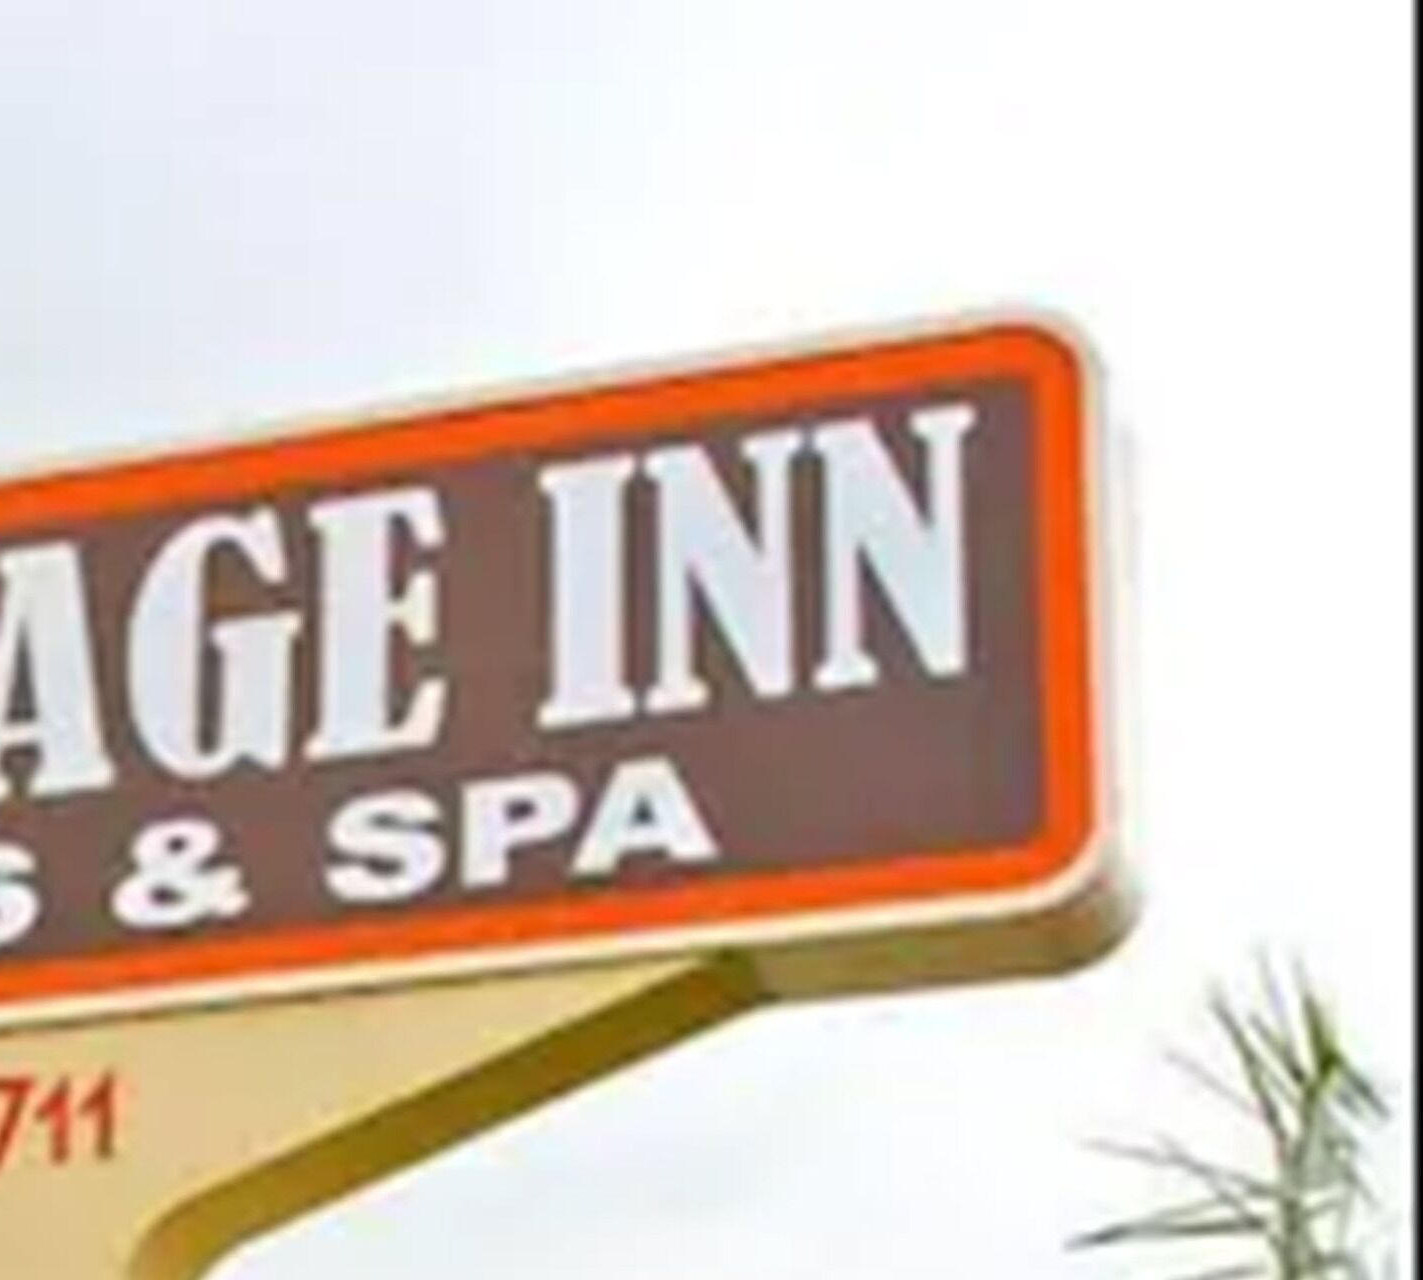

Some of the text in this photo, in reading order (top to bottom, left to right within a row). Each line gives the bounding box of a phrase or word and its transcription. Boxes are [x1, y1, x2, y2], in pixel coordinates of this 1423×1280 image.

[538, 404, 977, 730] INN
[112, 818, 249, 927] &
[325, 758, 717, 902] SPA
